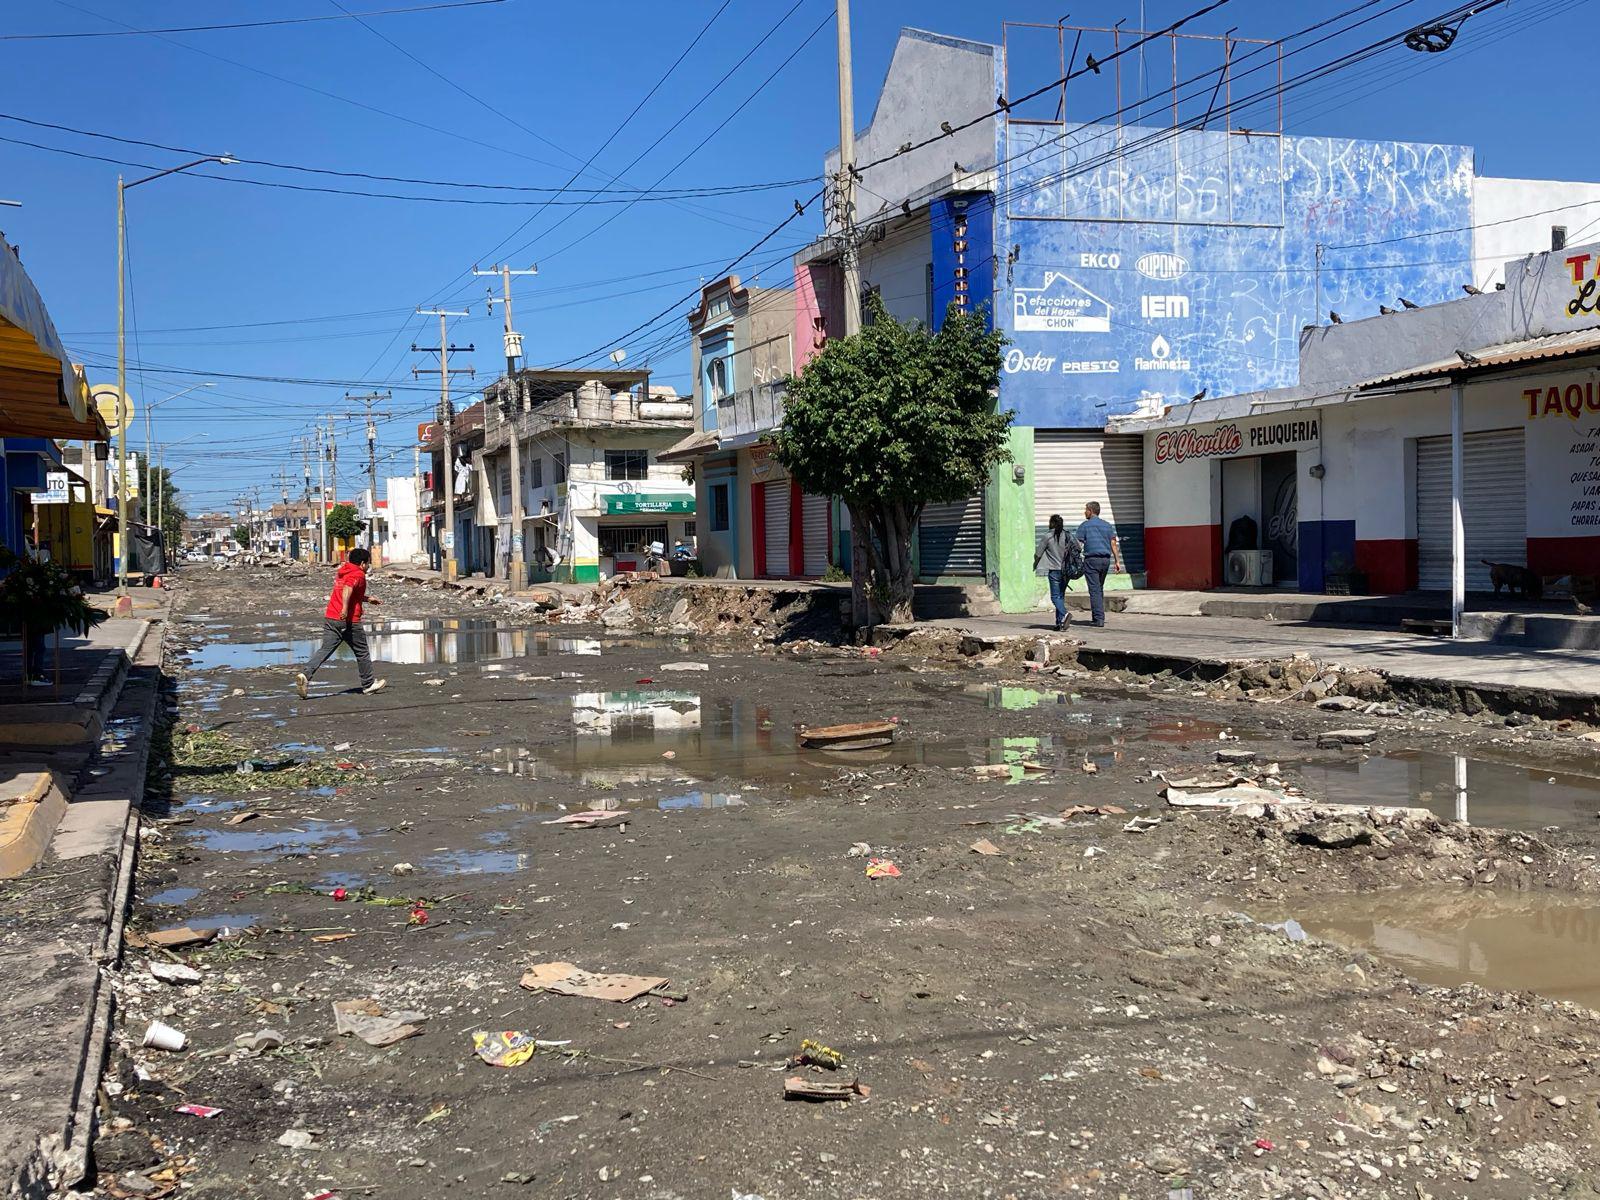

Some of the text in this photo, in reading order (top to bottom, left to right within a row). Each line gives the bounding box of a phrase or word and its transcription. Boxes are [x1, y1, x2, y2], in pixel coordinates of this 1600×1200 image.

[1080, 253, 1121, 269] EKCO
[1138, 254, 1187, 279] DUPONT
[1565, 253, 1600, 284] T
[1015, 293, 1092, 316] Refacciones
[1566, 279, 1600, 318] L
[1034, 306, 1080, 319] del Hogar
[1003, 349, 1056, 374] Oster
[1062, 360, 1120, 372] PRESTO
[1250, 420, 1319, 447] PELUQUERIA
[1155, 432, 1176, 464] El
[1569, 443, 1595, 454] ASADA
[1570, 500, 1596, 511] PAPAS
